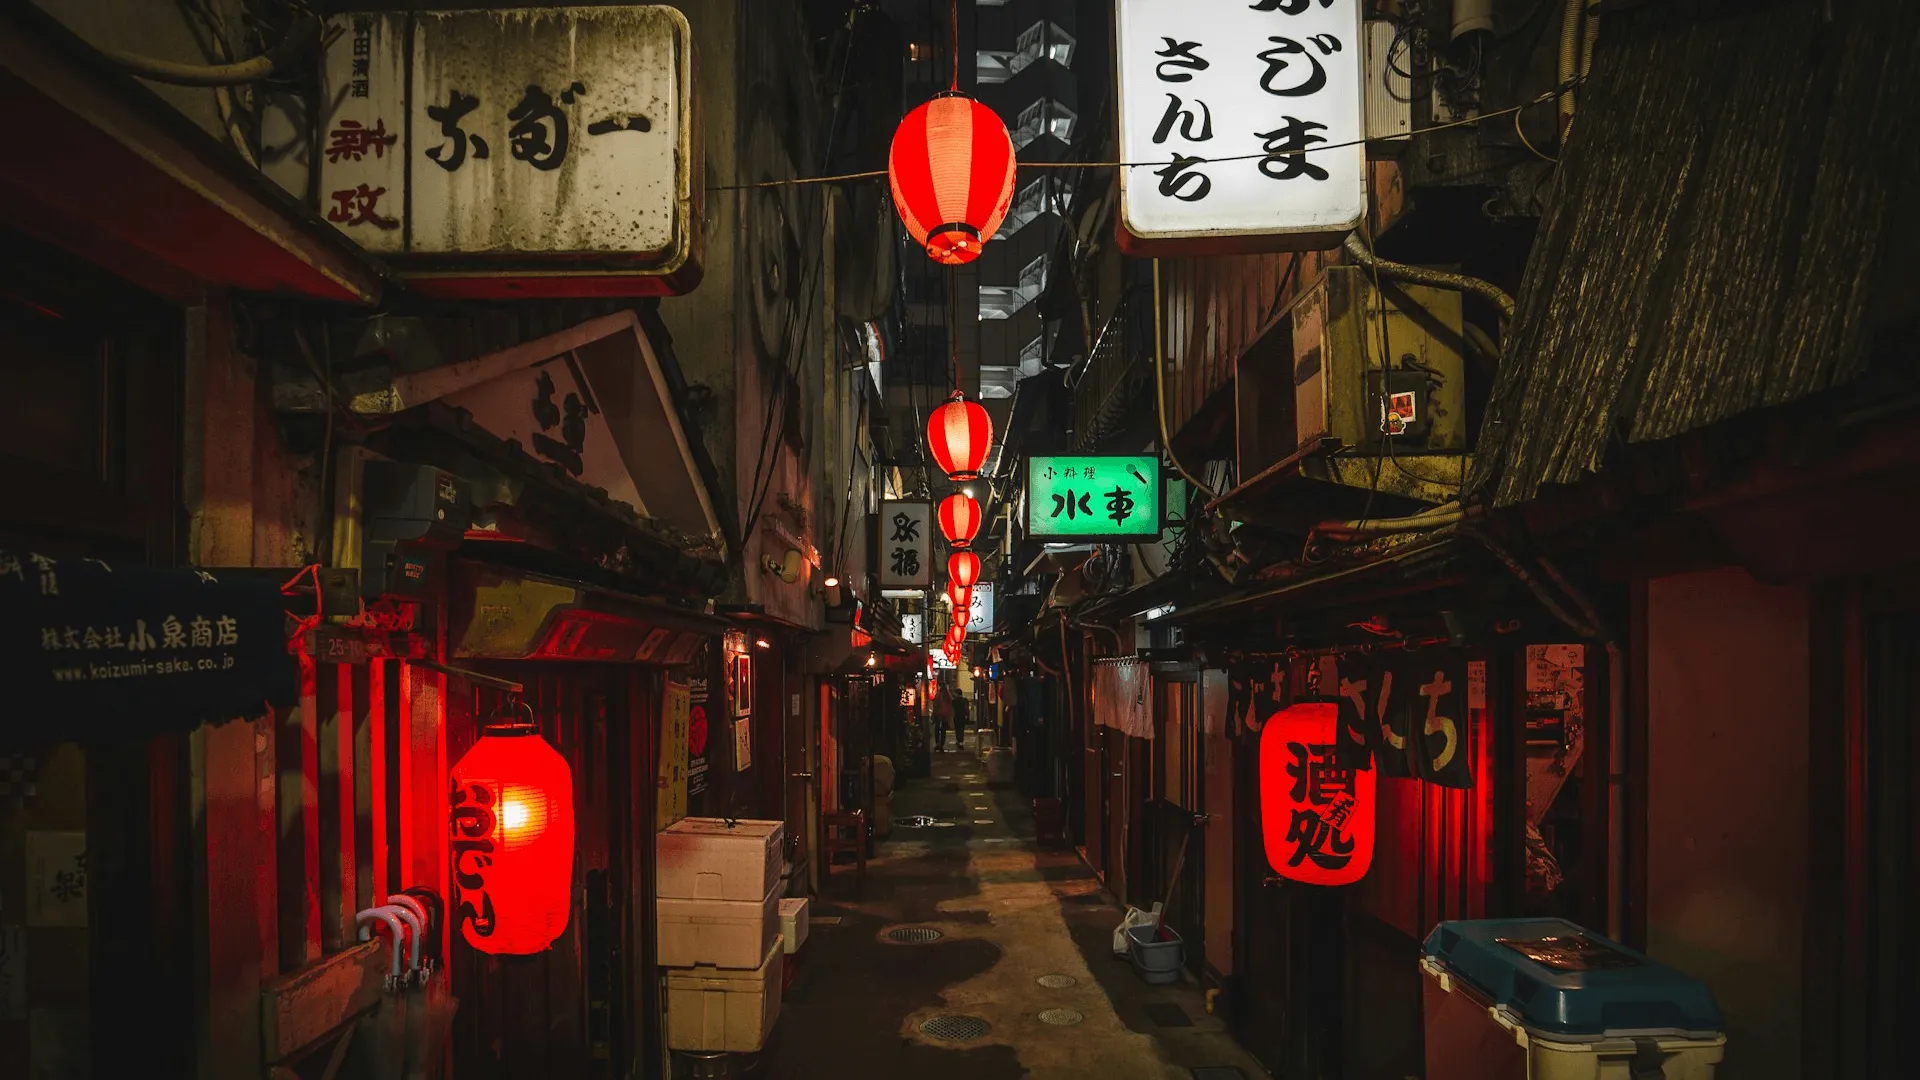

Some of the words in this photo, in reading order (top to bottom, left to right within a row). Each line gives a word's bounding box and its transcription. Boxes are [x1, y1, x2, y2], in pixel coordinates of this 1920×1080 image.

[1152, 36, 1214, 202] さんち
[325, 117, 400, 230] 新政
[1043, 466, 1096, 480] 小料理
[1050, 485, 1135, 527] 水車
[40, 614, 239, 652] 株式会社小泉商店
[1284, 742, 1356, 870] 酒処
